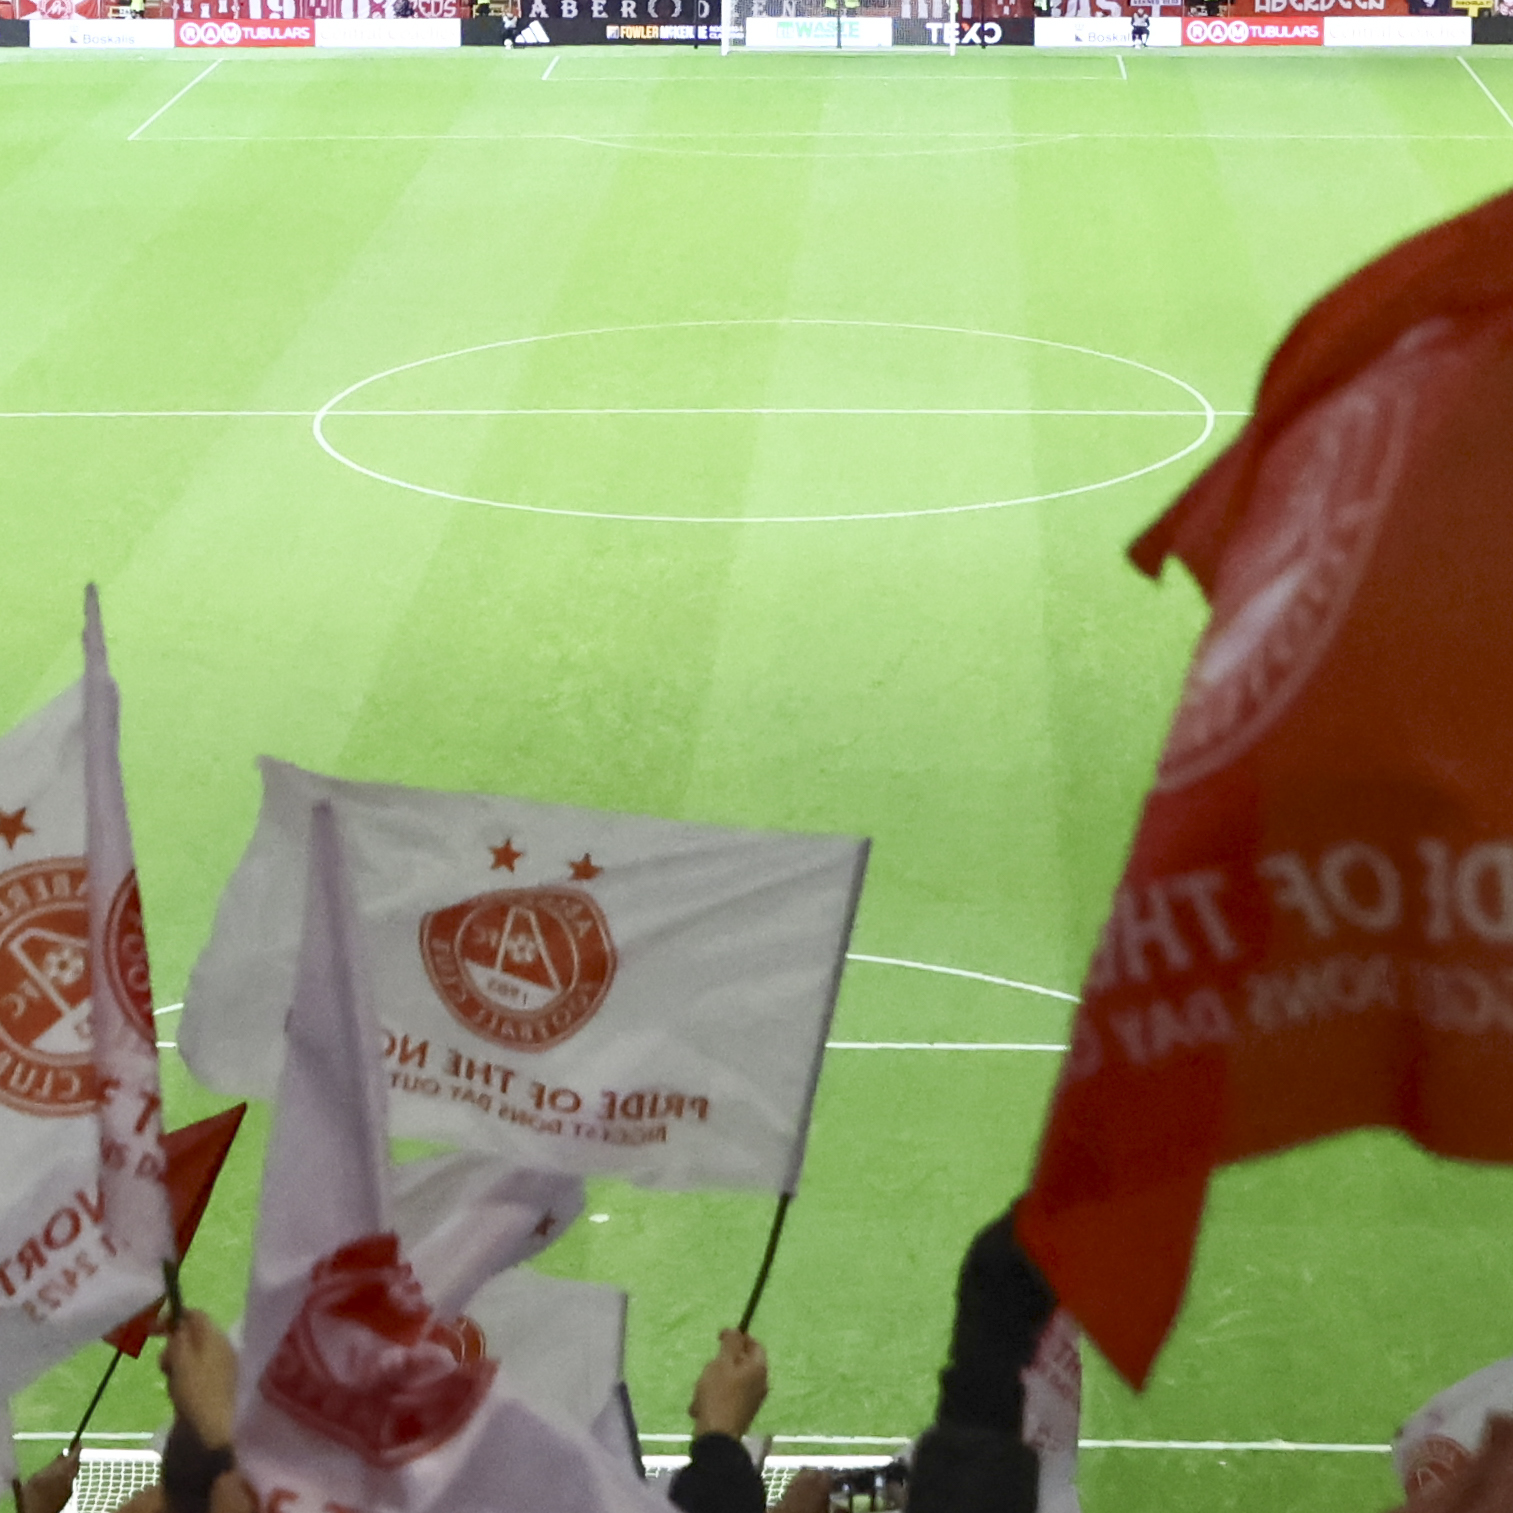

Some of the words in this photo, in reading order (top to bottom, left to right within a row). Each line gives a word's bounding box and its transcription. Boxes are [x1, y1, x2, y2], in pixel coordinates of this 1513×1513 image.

[82, 33, 136, 45] Boskalis
[180, 23, 242, 44] RAM
[242, 26, 311, 40] TUBULARS
[620, 25, 659, 39] FOWLER
[925, 22, 1003, 45] TEXO
[1088, 31, 1130, 43] Boskal
[1186, 20, 1250, 44] RAM
[1250, 25, 1319, 38] TUBULARS
